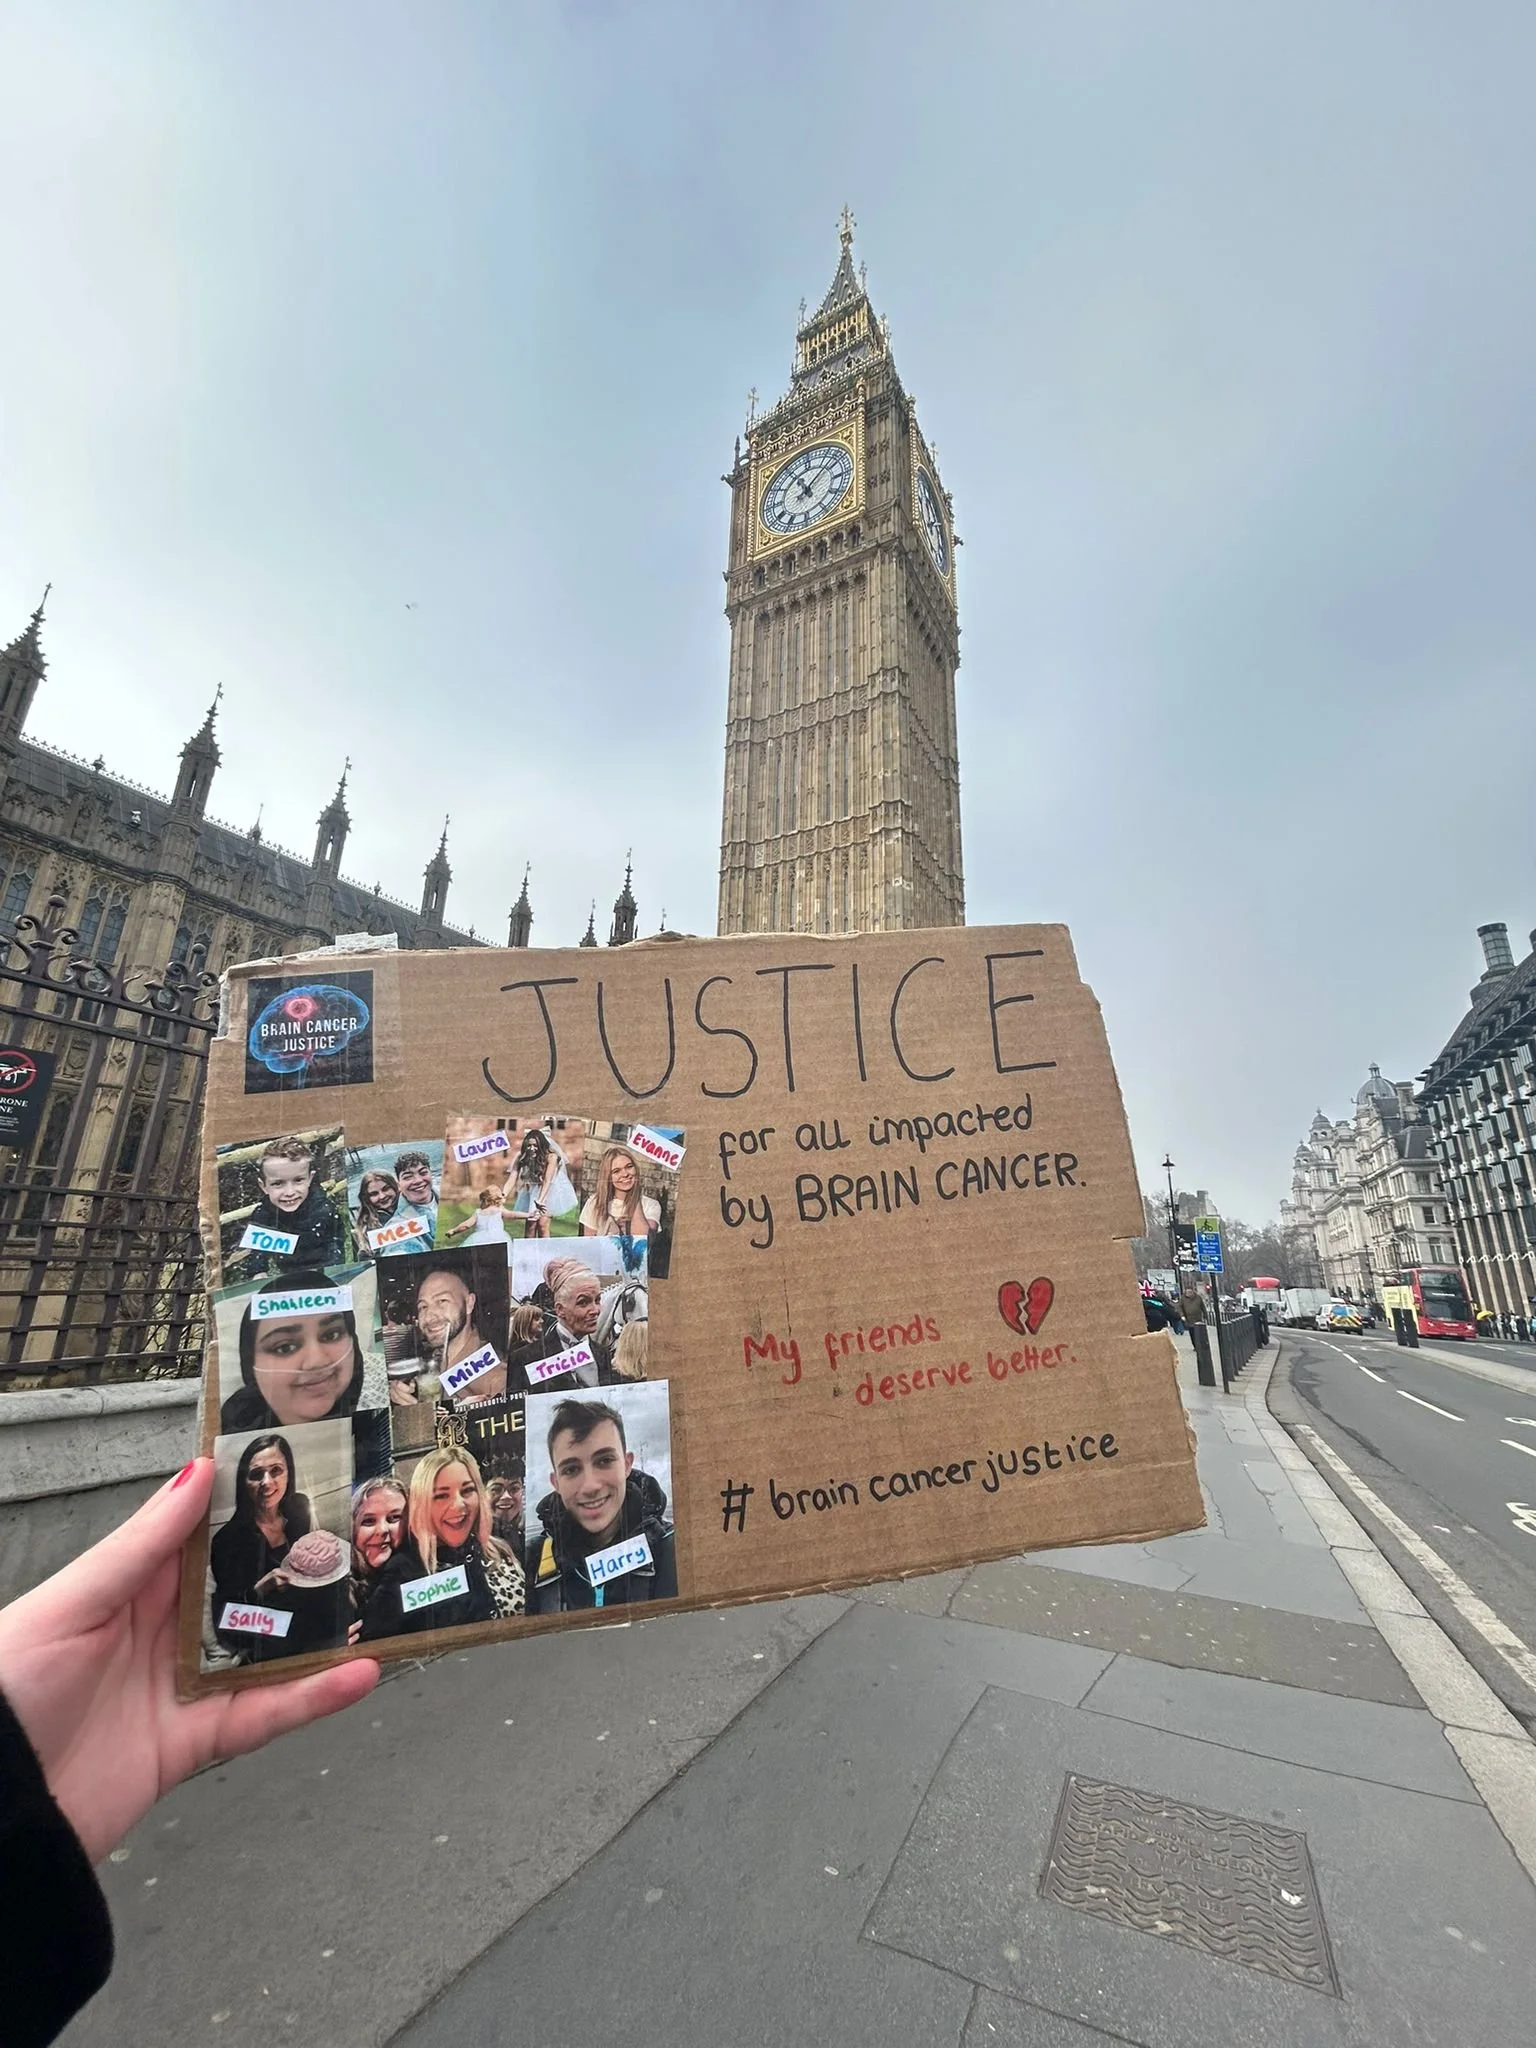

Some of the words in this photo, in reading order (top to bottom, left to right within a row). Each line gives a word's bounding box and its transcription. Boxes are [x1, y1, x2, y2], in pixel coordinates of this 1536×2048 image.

[260, 1020, 301, 1038] BRAIN
[306, 1017, 358, 1034] CANCER
[481, 949, 1057, 1103] JUSTICE
[283, 1035, 336, 1052] JUSTICE
[0, 1096, 28, 1108] RONE
[457, 1134, 509, 1159] Laura
[632, 1131, 679, 1168] Evanne
[719, 1126, 776, 1180] for
[795, 1117, 851, 1153] all
[868, 1092, 1034, 1153] impacted
[719, 1185, 774, 1250] by
[795, 1167, 920, 1223] BRAIN
[935, 1151, 1088, 1201] CANCER.
[535, 1349, 591, 1379] Tricia
[743, 1332, 802, 1386] My
[824, 1313, 941, 1371] friends
[447, 1350, 496, 1389] Mike
[854, 1359, 973, 1407] deserve
[986, 1341, 1078, 1382] better.
[474, 1410, 526, 1439] THE
[590, 1547, 647, 1580] Harry
[406, 1576, 463, 1608] Sophie
[228, 1609, 276, 1635] Sally
